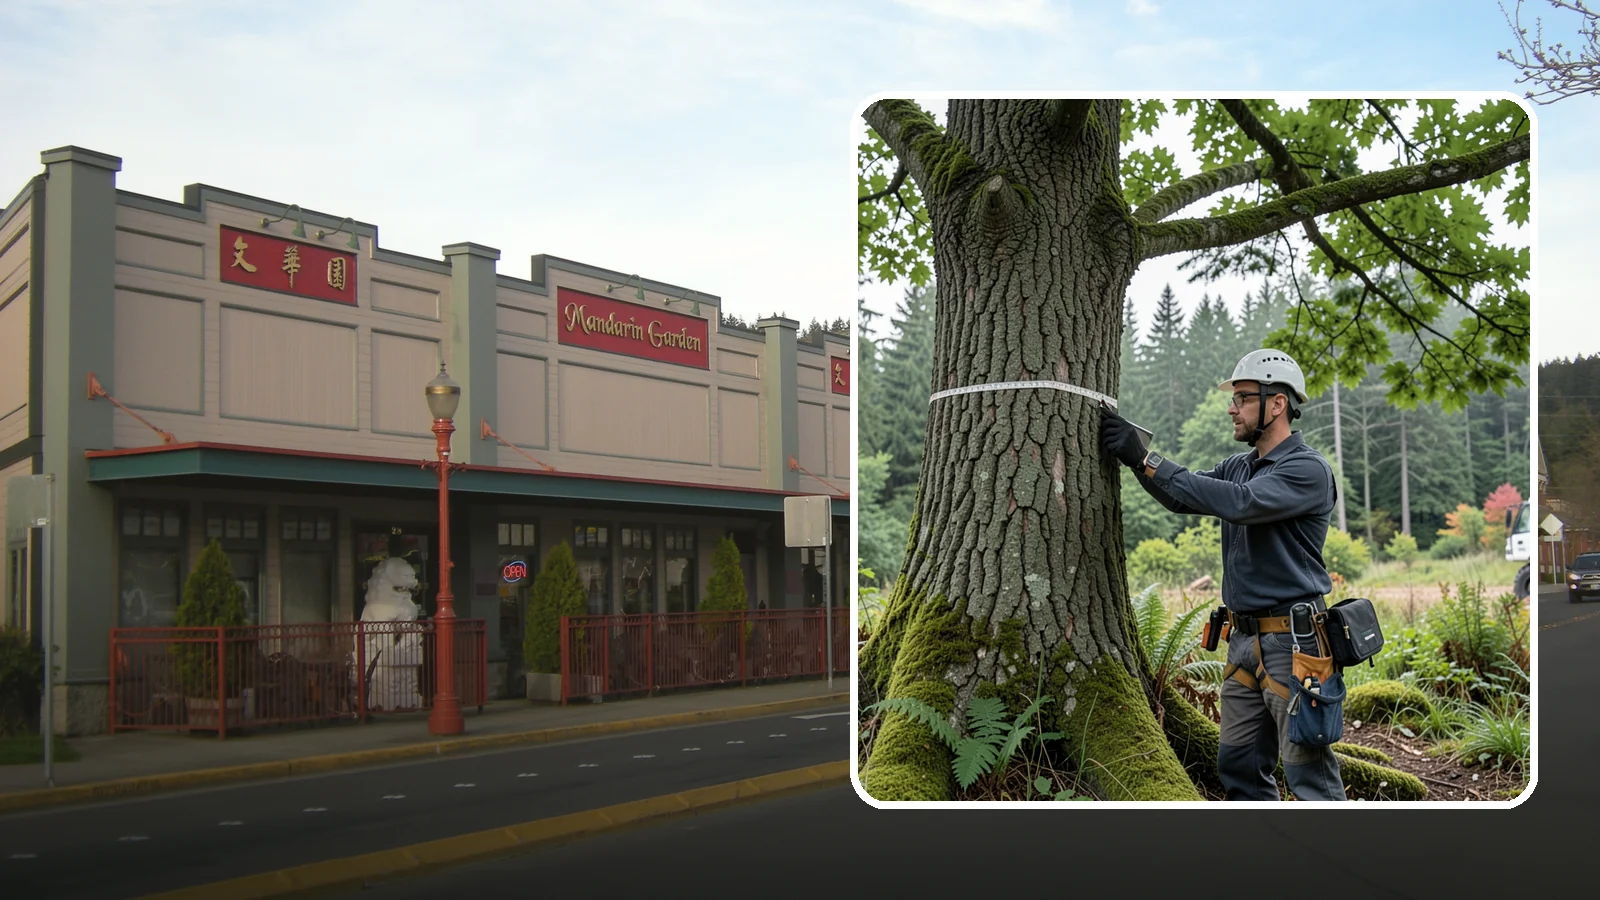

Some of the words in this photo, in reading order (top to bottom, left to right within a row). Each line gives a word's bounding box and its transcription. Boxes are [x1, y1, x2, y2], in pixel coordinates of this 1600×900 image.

[564, 302, 644, 341] Mandarin
[648, 320, 701, 352] Garden
[835, 363, 846, 386] 文
[503, 565, 527, 578] OPEN
